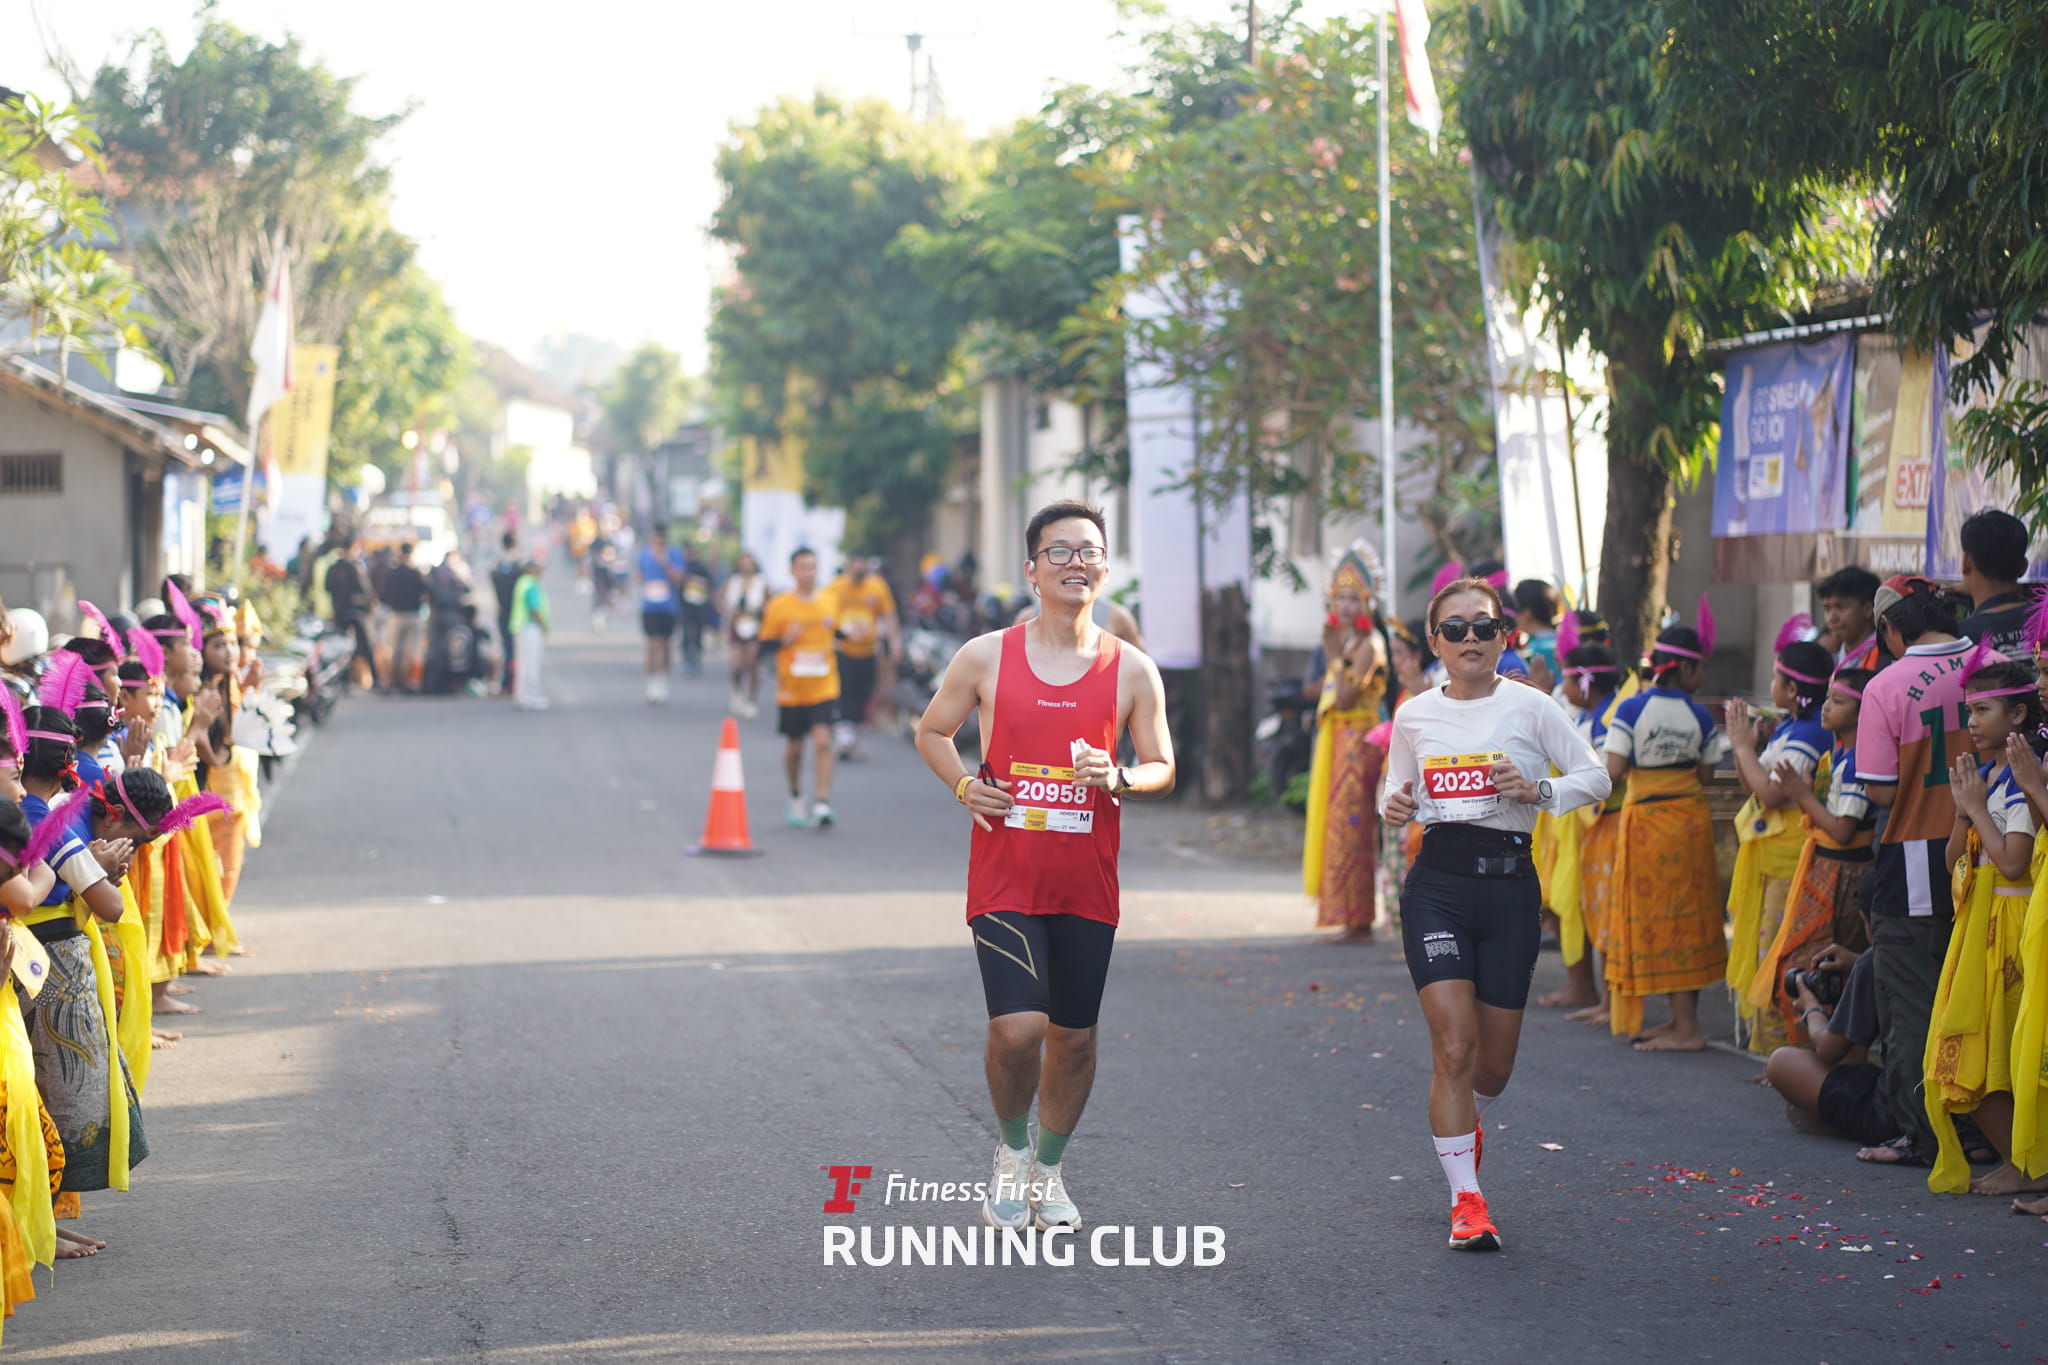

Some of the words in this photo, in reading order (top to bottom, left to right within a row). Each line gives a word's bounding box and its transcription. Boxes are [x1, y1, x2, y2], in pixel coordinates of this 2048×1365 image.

[1907, 656, 1997, 702] HAIM
[1037, 699, 1061, 708] Fitness
[1062, 700, 1077, 708] First
[1015, 779, 1088, 805] 20958
[1079, 812, 1090, 822] M
